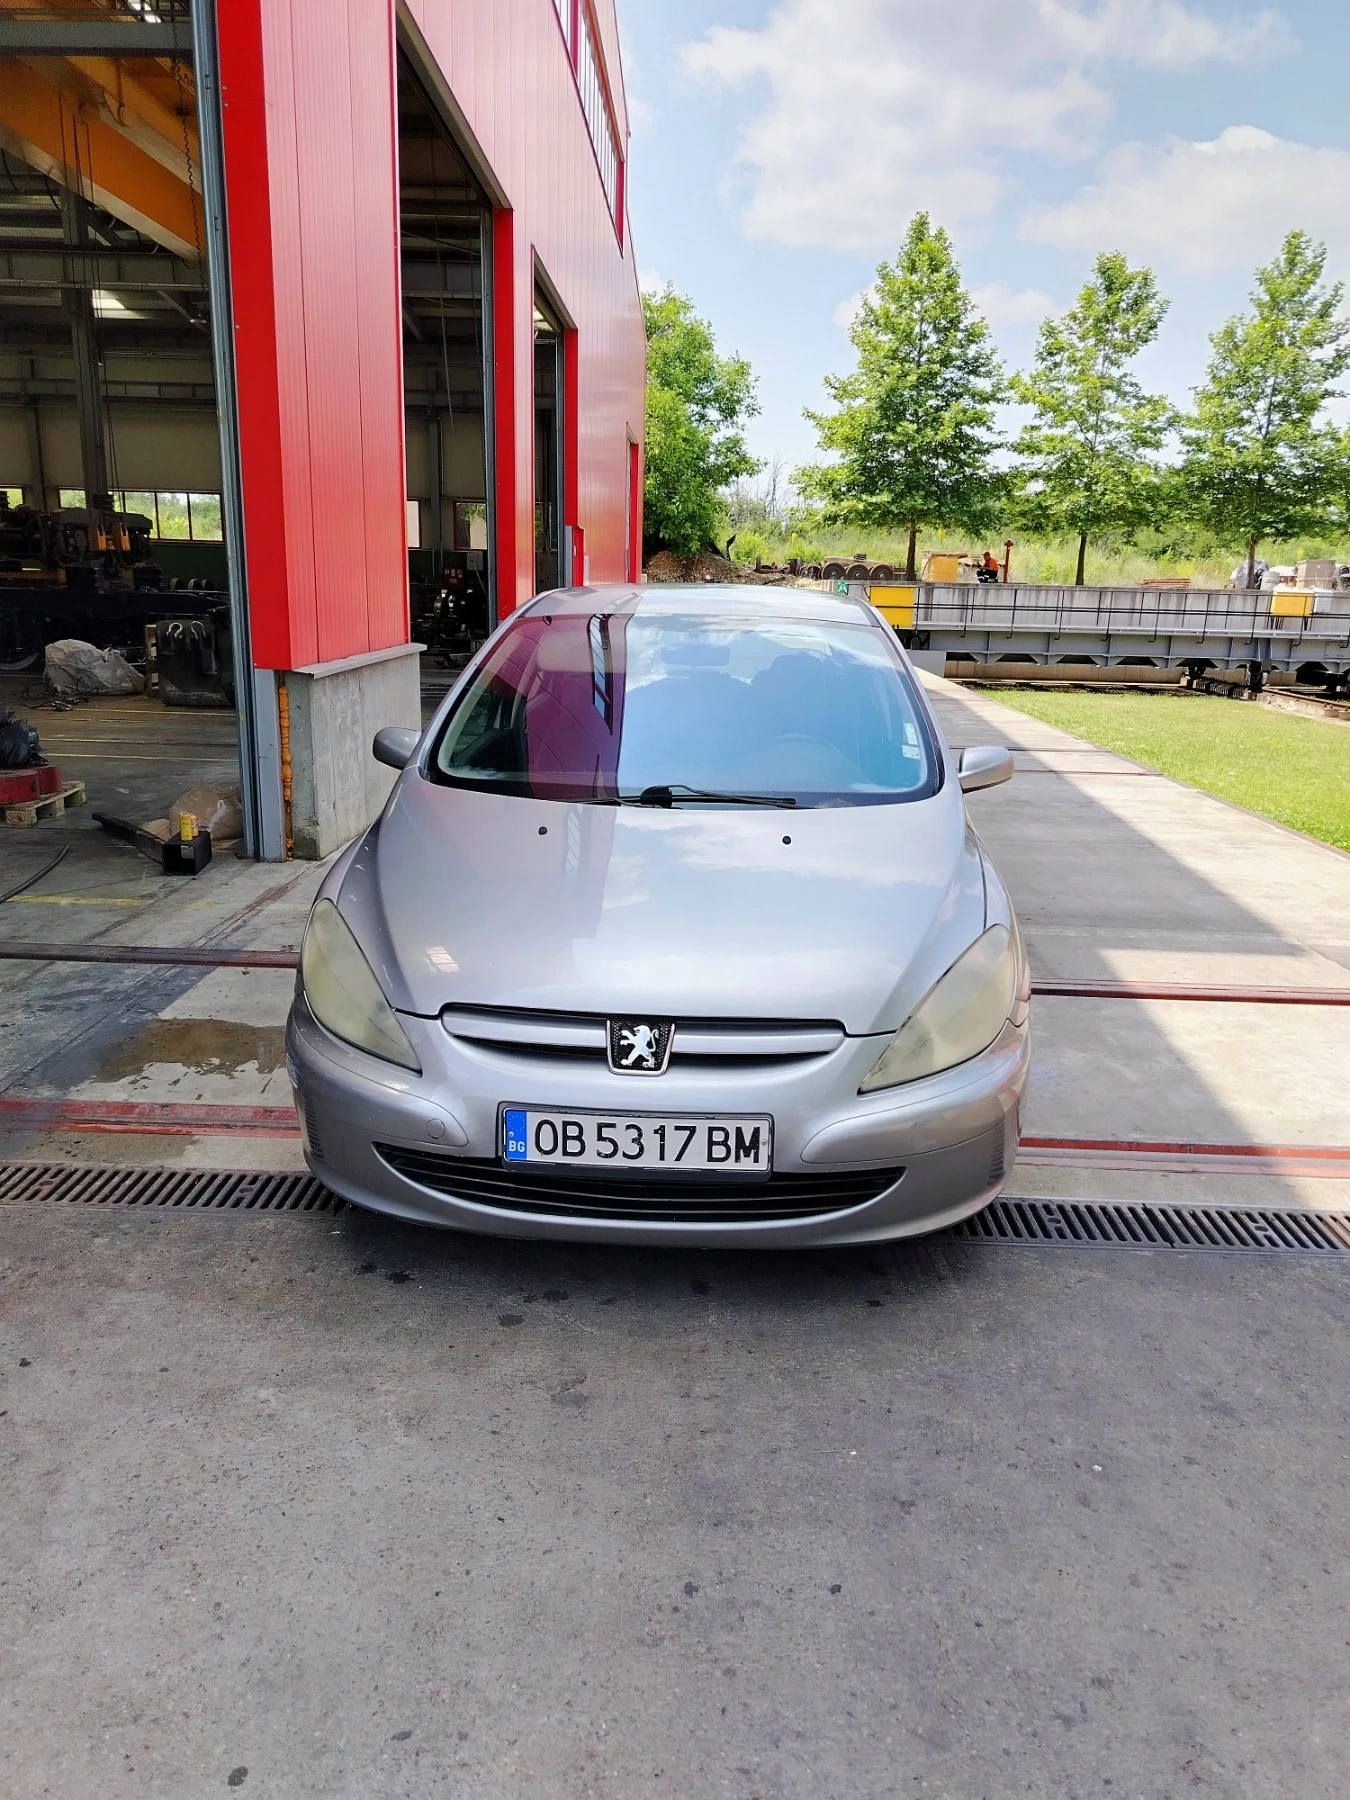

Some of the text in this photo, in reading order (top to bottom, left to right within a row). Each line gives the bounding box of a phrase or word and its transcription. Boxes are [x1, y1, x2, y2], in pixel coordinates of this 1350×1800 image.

[508, 1139, 526, 1153] BG
[534, 1119, 760, 1164] OB 5317 BM
